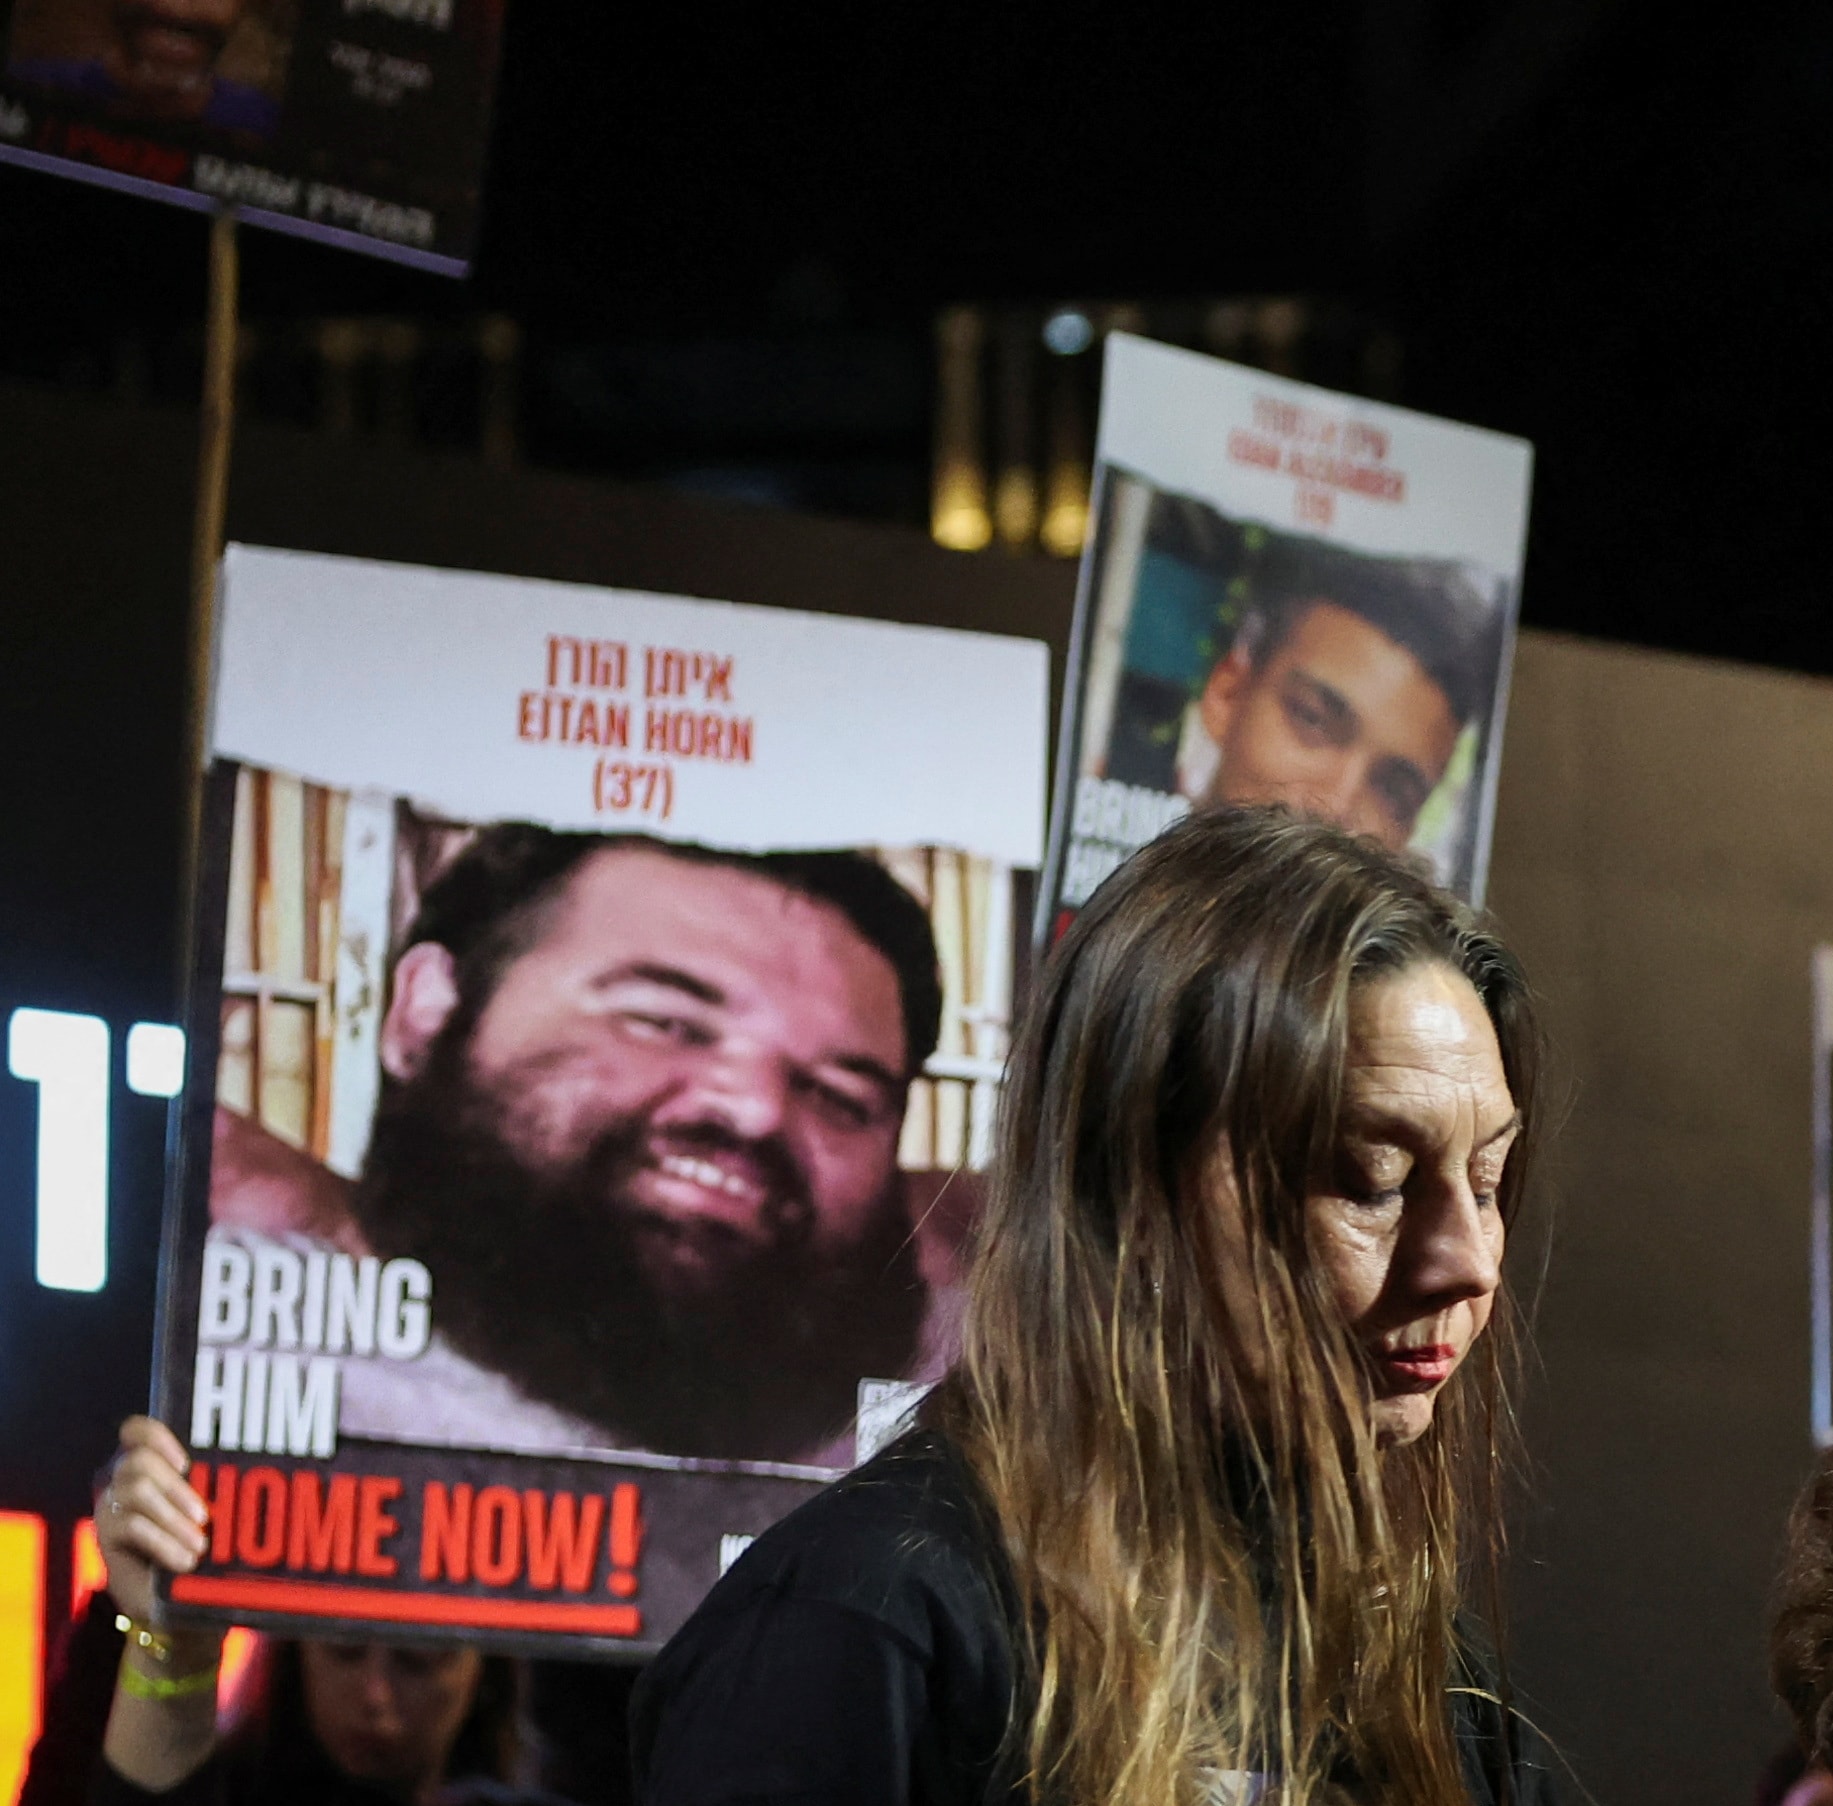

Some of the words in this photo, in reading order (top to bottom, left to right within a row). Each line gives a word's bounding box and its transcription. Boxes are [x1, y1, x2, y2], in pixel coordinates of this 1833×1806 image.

[547, 634, 628, 690] הורן
[645, 645, 733, 702] איתן
[518, 690, 629, 748] EITAN
[646, 706, 754, 763] HORN
[593, 755, 674, 821] (37)
[198, 1240, 433, 1359] BRING
[190, 1346, 339, 1459] HIM
[190, 1461, 403, 1578] HOME
[419, 1481, 644, 1598] NOW!
